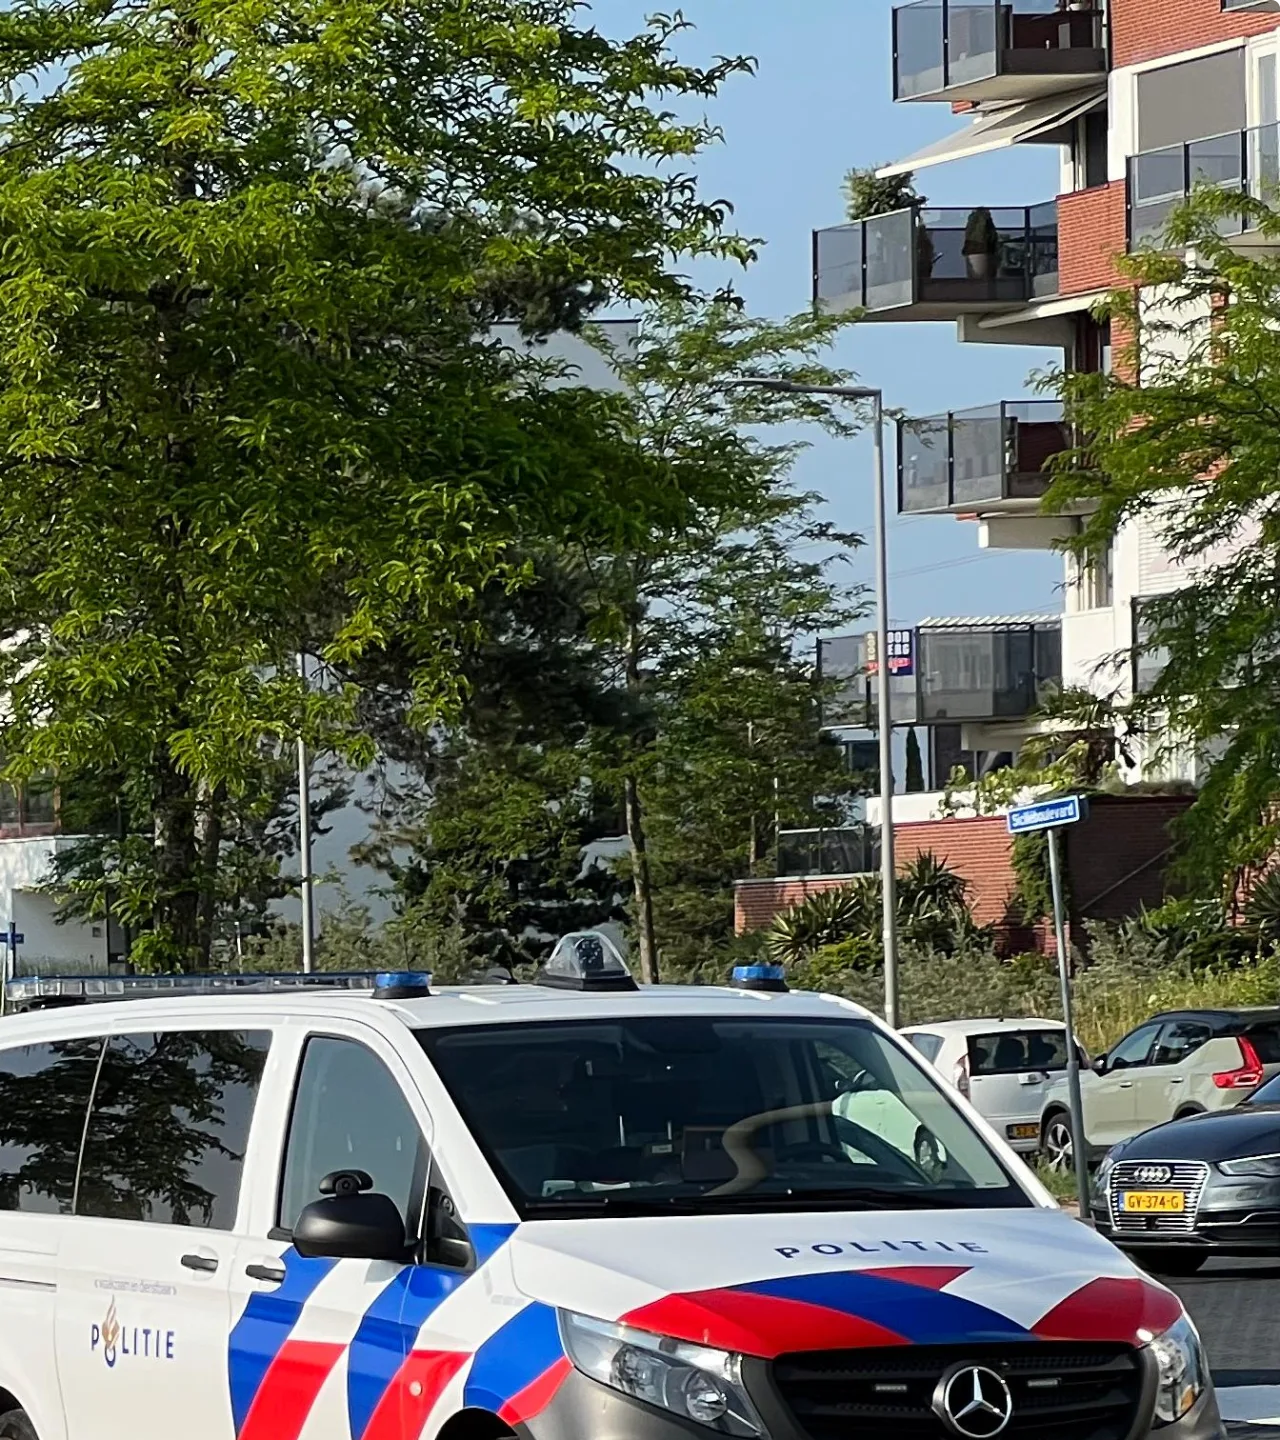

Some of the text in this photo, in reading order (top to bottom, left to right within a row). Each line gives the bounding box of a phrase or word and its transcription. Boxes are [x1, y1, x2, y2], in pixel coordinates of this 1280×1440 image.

[1128, 1195, 1179, 1209] GV-374-G
[774, 1240, 989, 1259] POLITIE
[91, 1323, 175, 1368] POLITIE
